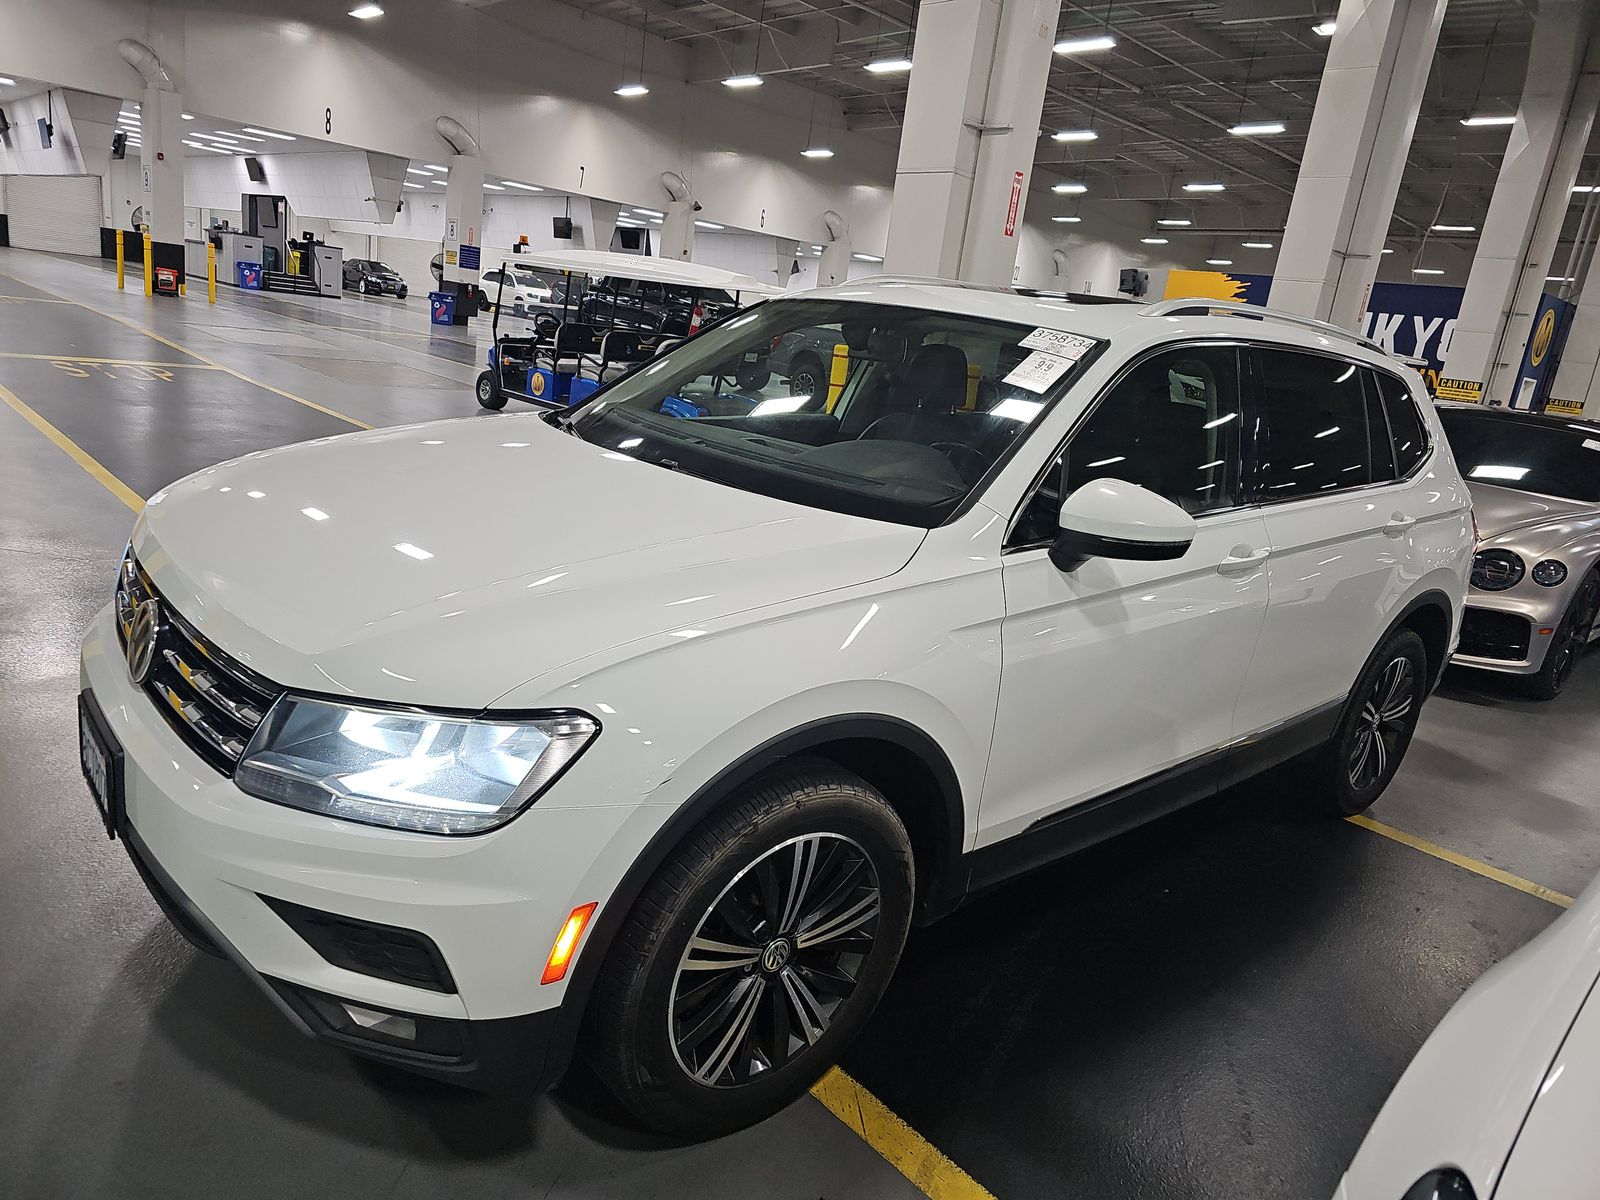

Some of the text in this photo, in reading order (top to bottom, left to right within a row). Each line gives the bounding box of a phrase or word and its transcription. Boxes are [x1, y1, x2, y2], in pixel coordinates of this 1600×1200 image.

[325, 107, 332, 135] 8
[144, 171, 149, 187] 9
[579, 166, 585, 188] 7
[760, 208, 766, 228] 6
[449, 224, 455, 237] 8
[1032, 329, 1094, 350] 3758734
[1440, 378, 1480, 391] CAUTION
[1549, 398, 1583, 409] CAUTION
